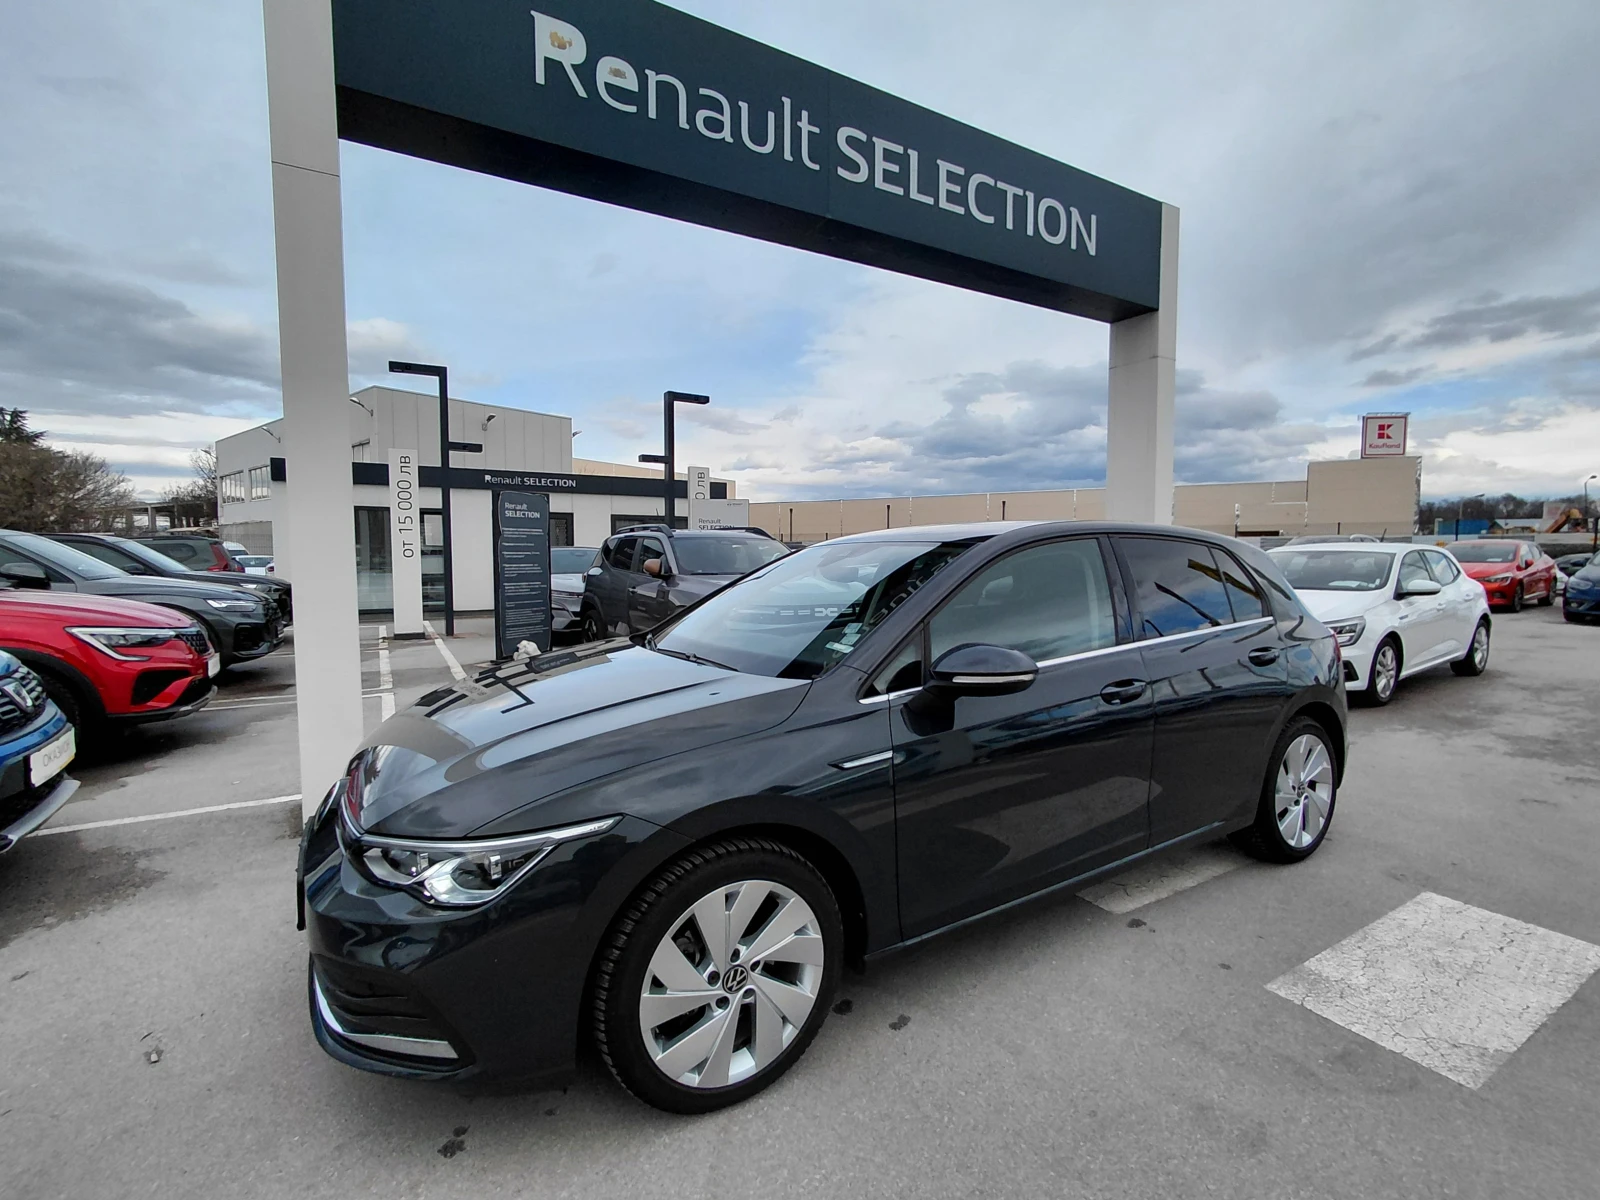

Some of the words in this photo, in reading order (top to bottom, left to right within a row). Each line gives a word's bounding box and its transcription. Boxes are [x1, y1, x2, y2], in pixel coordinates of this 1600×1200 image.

[530, 10, 820, 172] Renault
[836, 126, 1097, 256] SELECTION
[484, 474, 522, 485] Renault
[523, 477, 576, 487] SELECTION
[396, 479, 413, 511] 000
[504, 502, 527, 510] Renault
[398, 515, 414, 534] 15
